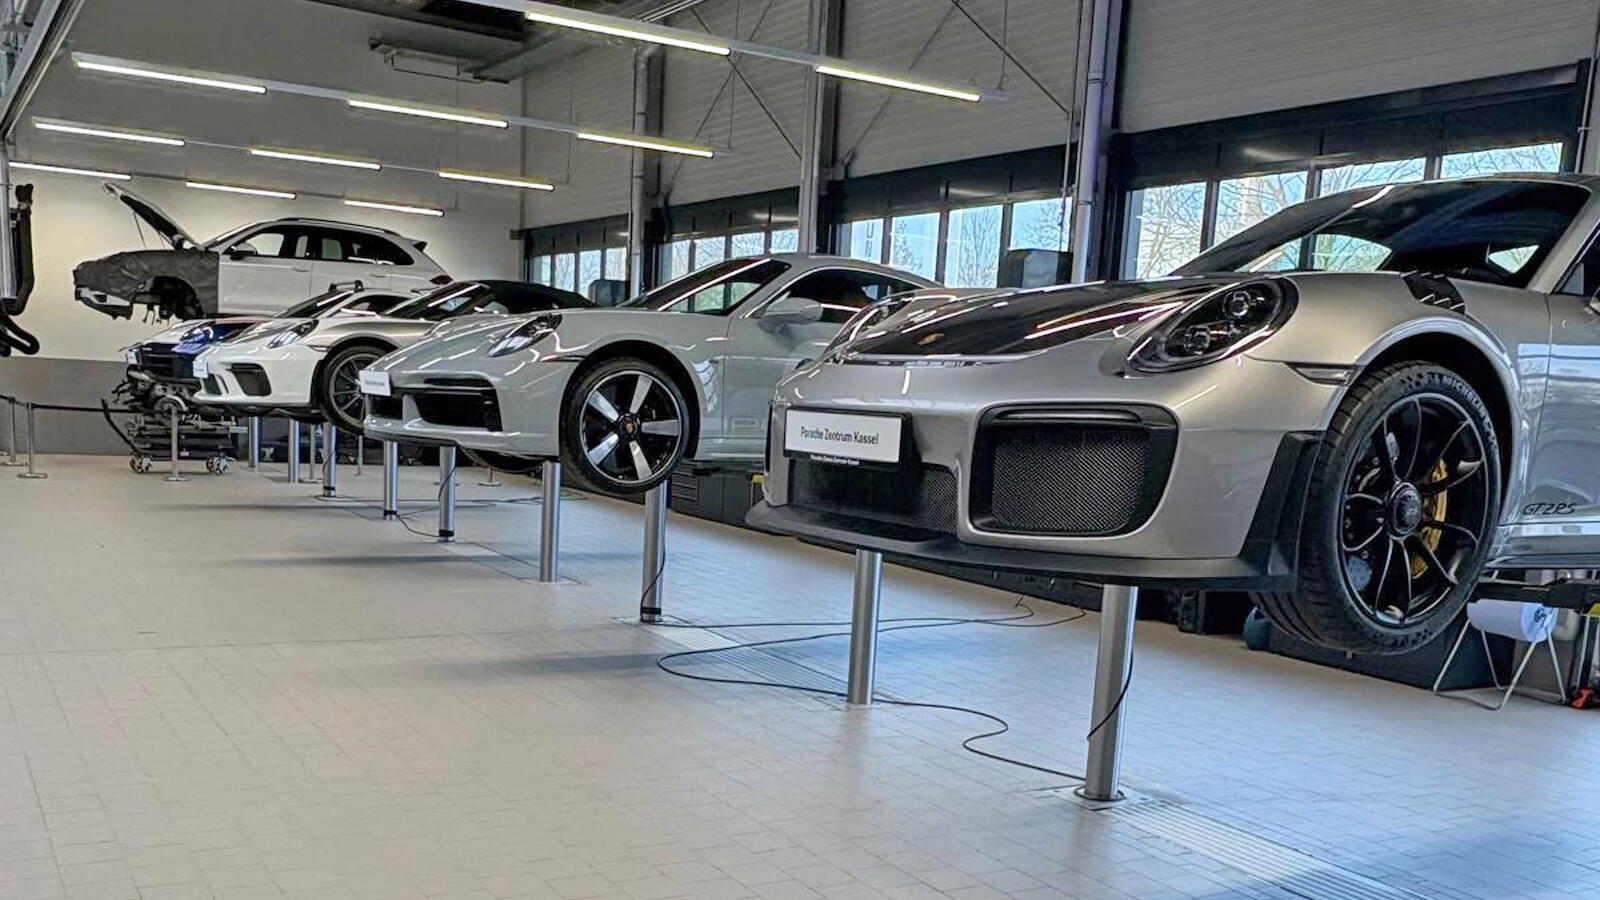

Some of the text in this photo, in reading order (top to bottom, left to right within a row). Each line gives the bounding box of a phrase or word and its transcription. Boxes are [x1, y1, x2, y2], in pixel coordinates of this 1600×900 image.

[800, 426, 879, 445] Porsche Zentrum Kassel
